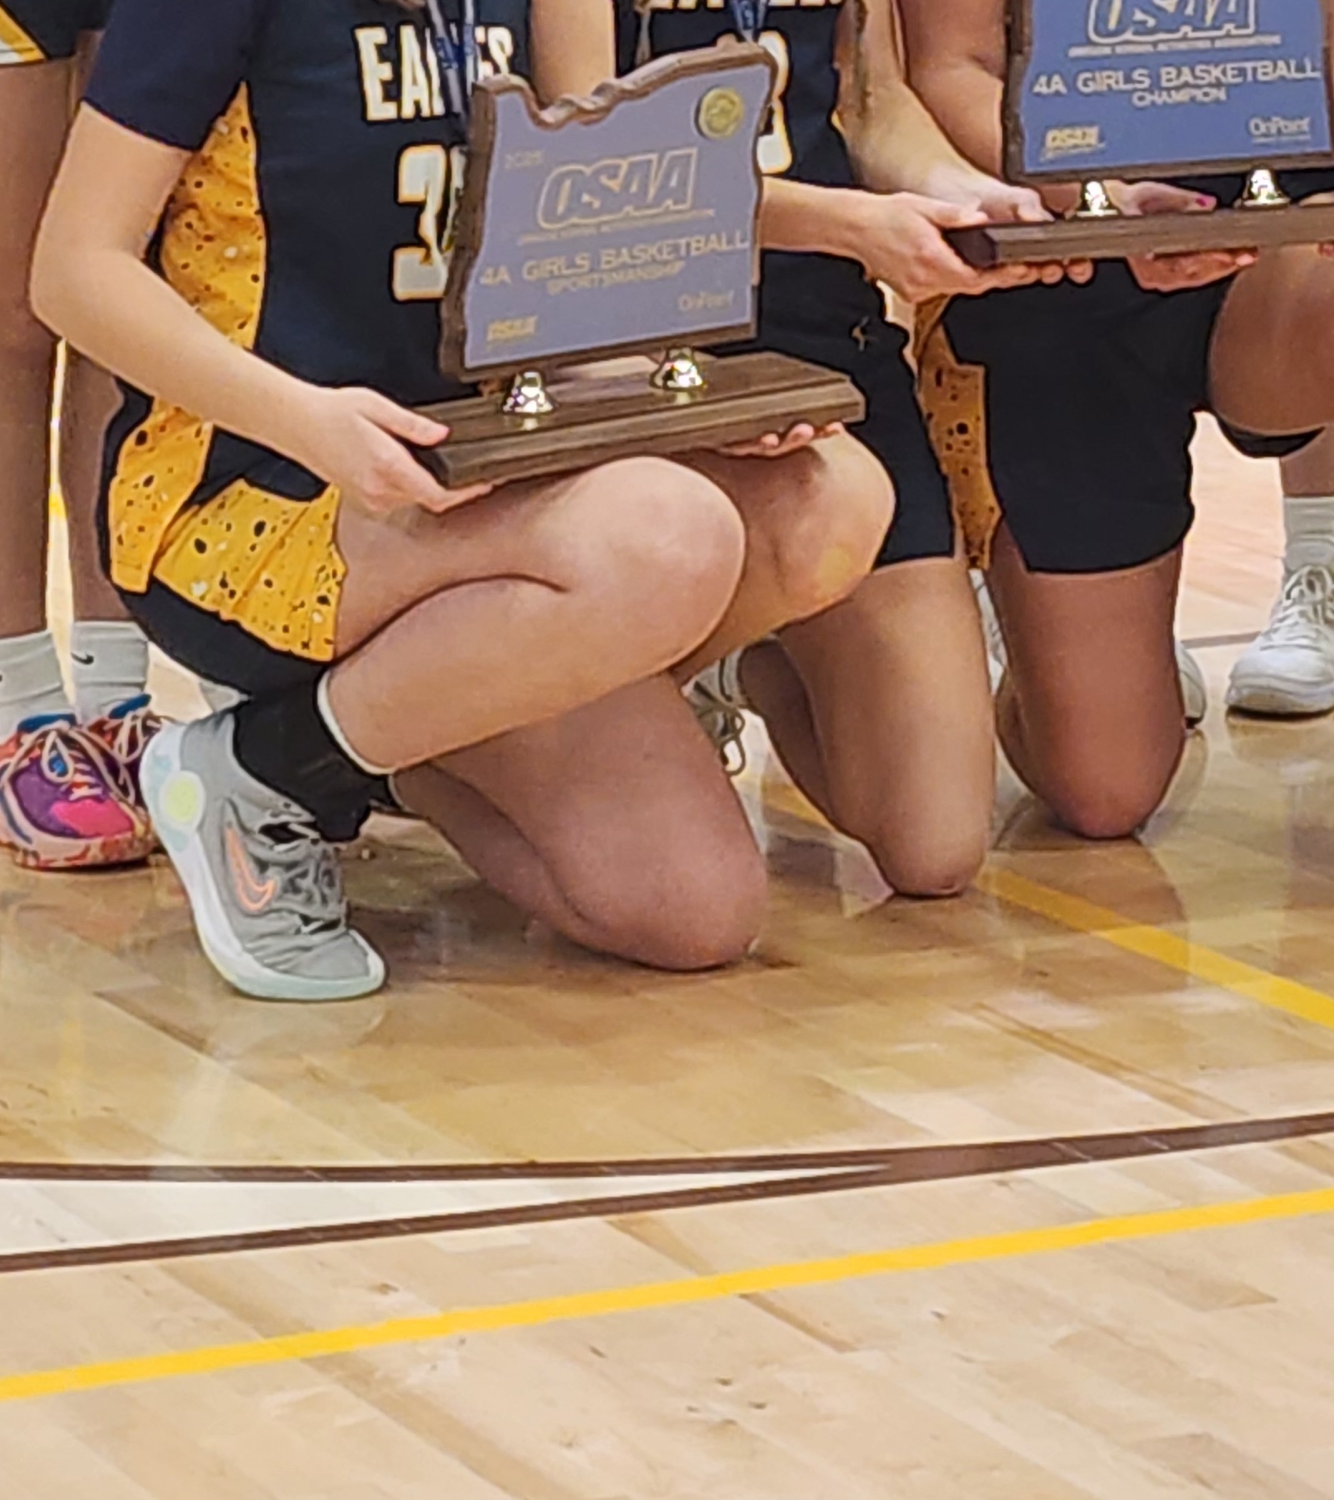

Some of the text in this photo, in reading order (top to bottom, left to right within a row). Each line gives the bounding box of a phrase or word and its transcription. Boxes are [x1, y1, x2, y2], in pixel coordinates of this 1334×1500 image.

[1033, 56, 1322, 95] 4A GIRLS BASKETBALL
[537, 148, 698, 230] OSAA
[523, 252, 592, 282] GIRLS
[600, 229, 751, 270] BASKETBALL
